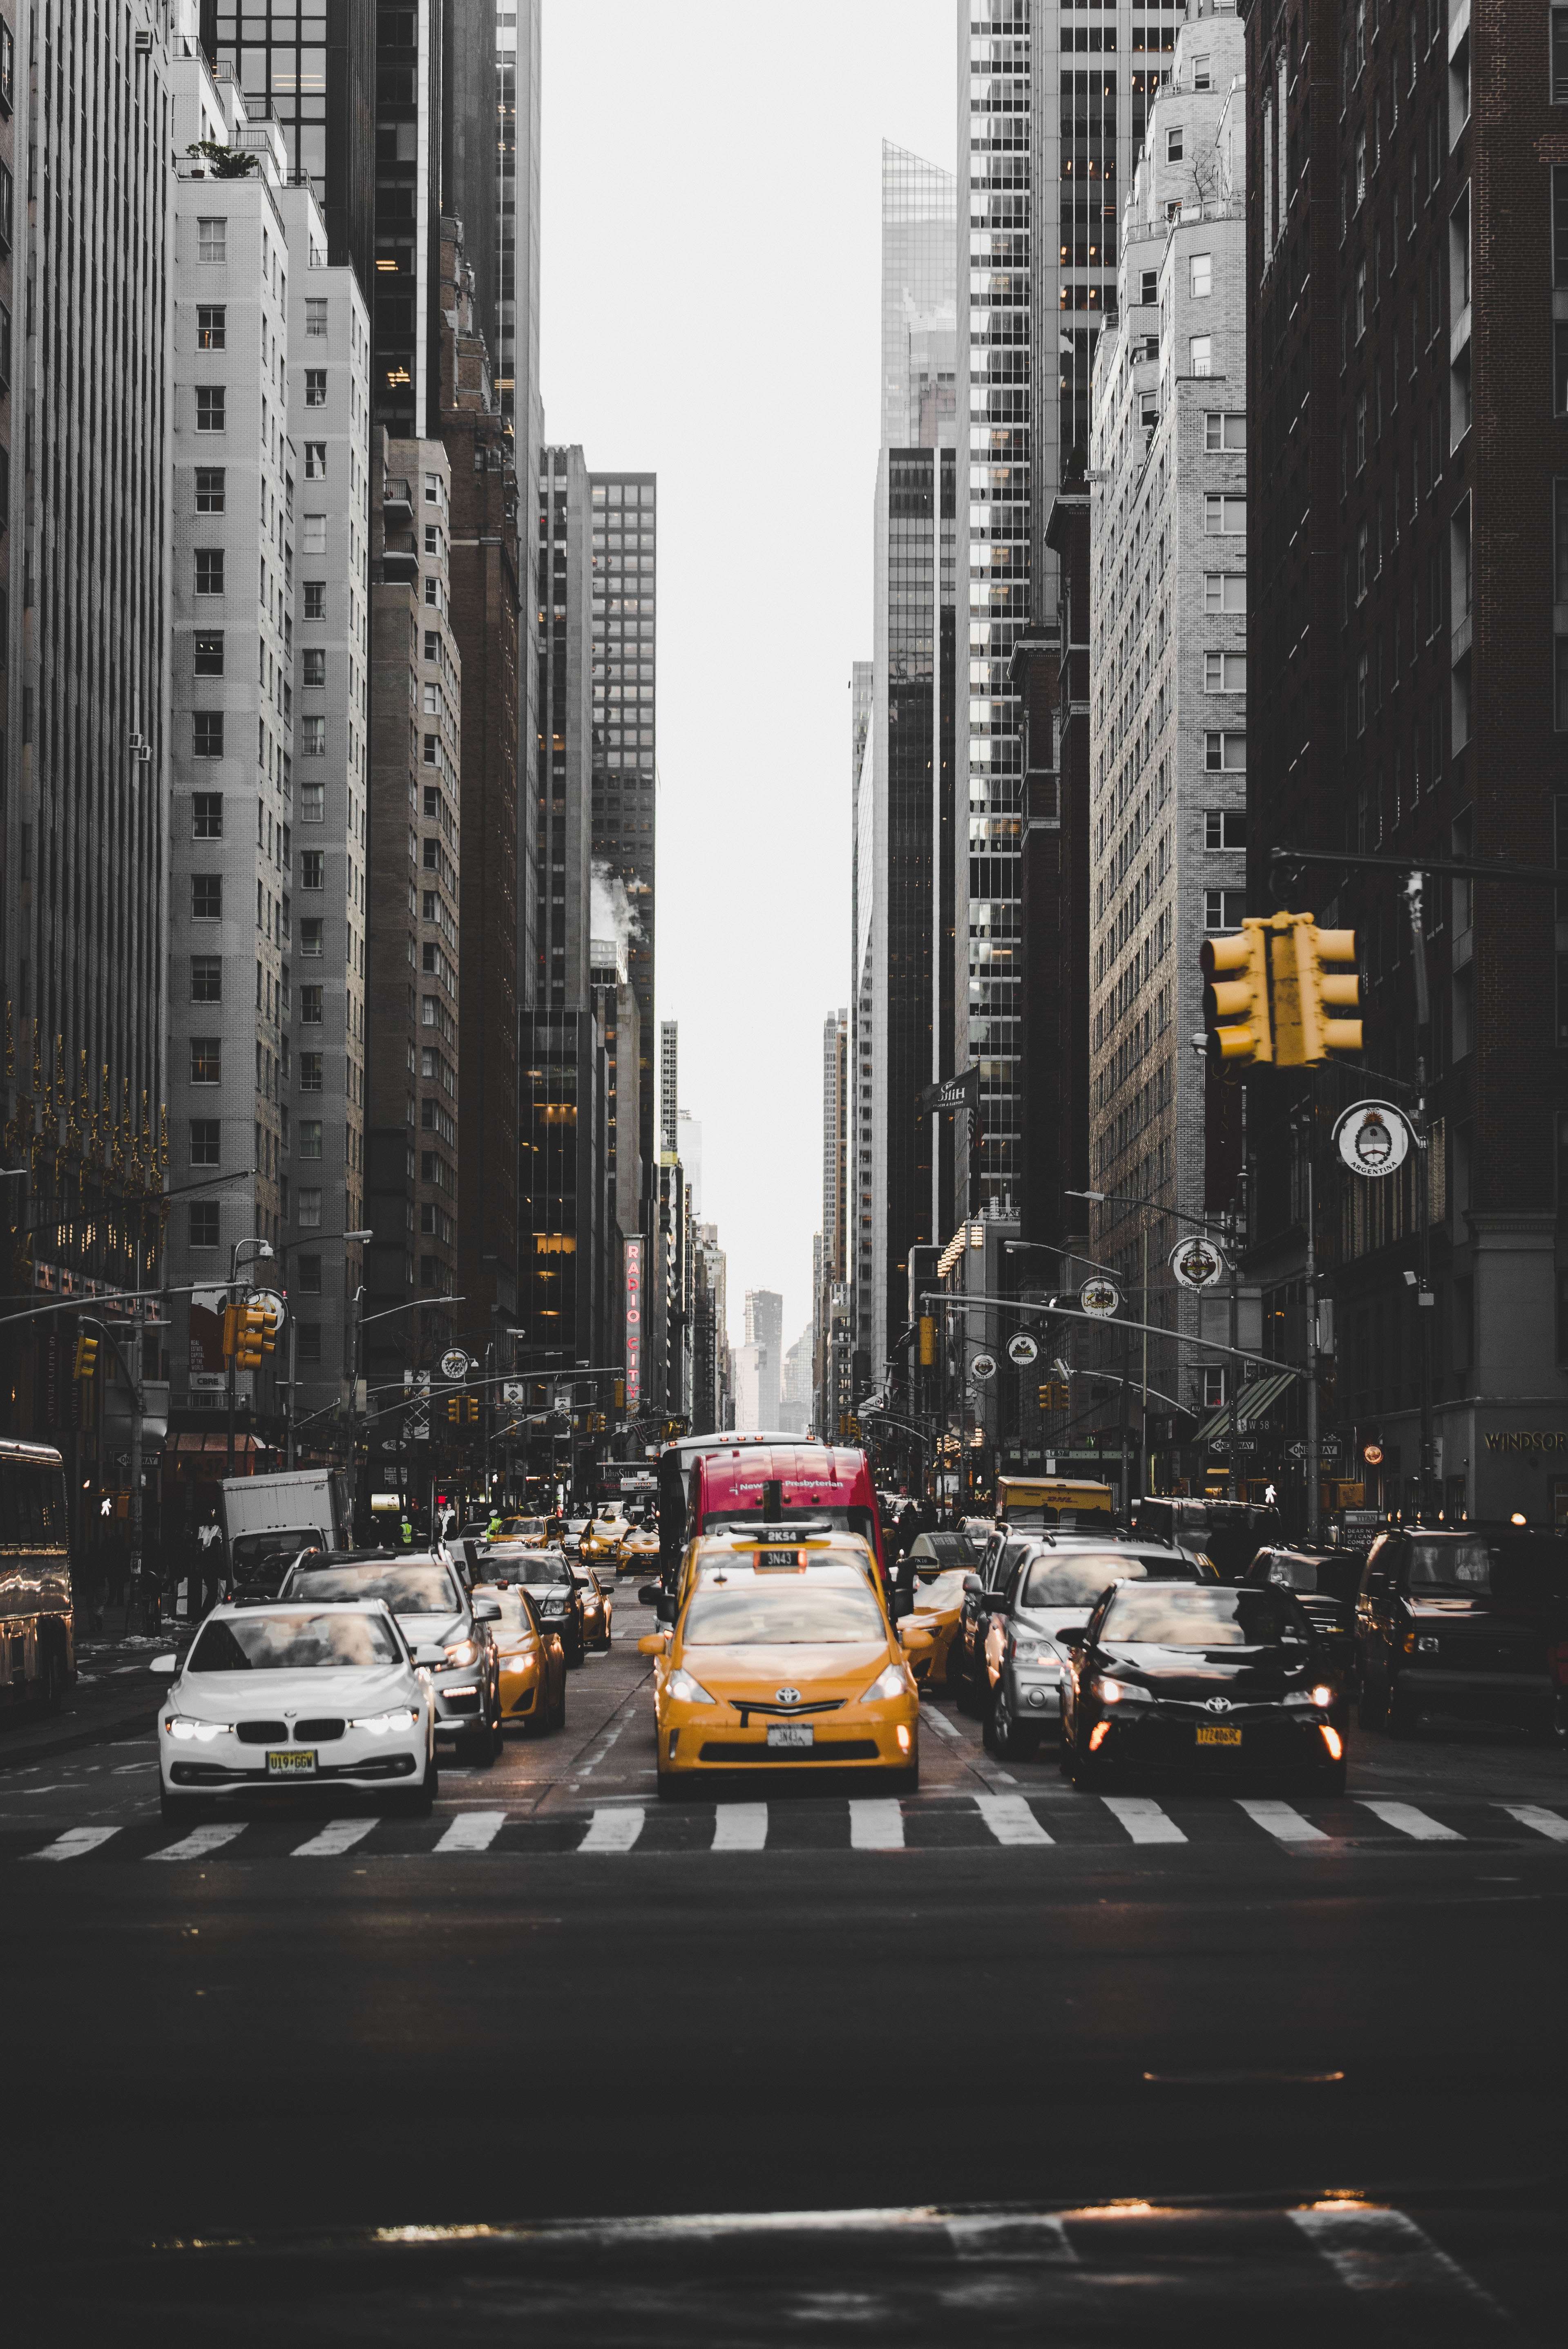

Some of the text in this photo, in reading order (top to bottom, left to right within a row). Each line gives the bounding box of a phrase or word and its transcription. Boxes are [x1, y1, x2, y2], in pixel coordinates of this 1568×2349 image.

[1350, 1161, 1397, 1174] ARGENTINA
[627, 1245, 640, 1323] RADIO
[627, 1337, 640, 1398] CITY
[1249, 1421, 1256, 1430] W
[1260, 1421, 1269, 1430] 58
[1484, 1432, 1567, 1452] WINDSOR
[121, 1456, 132, 1465] ON
[601, 1466, 619, 1480] Julius
[768, 1531, 797, 1541] 2K54
[768, 1552, 792, 1565] 3N43
